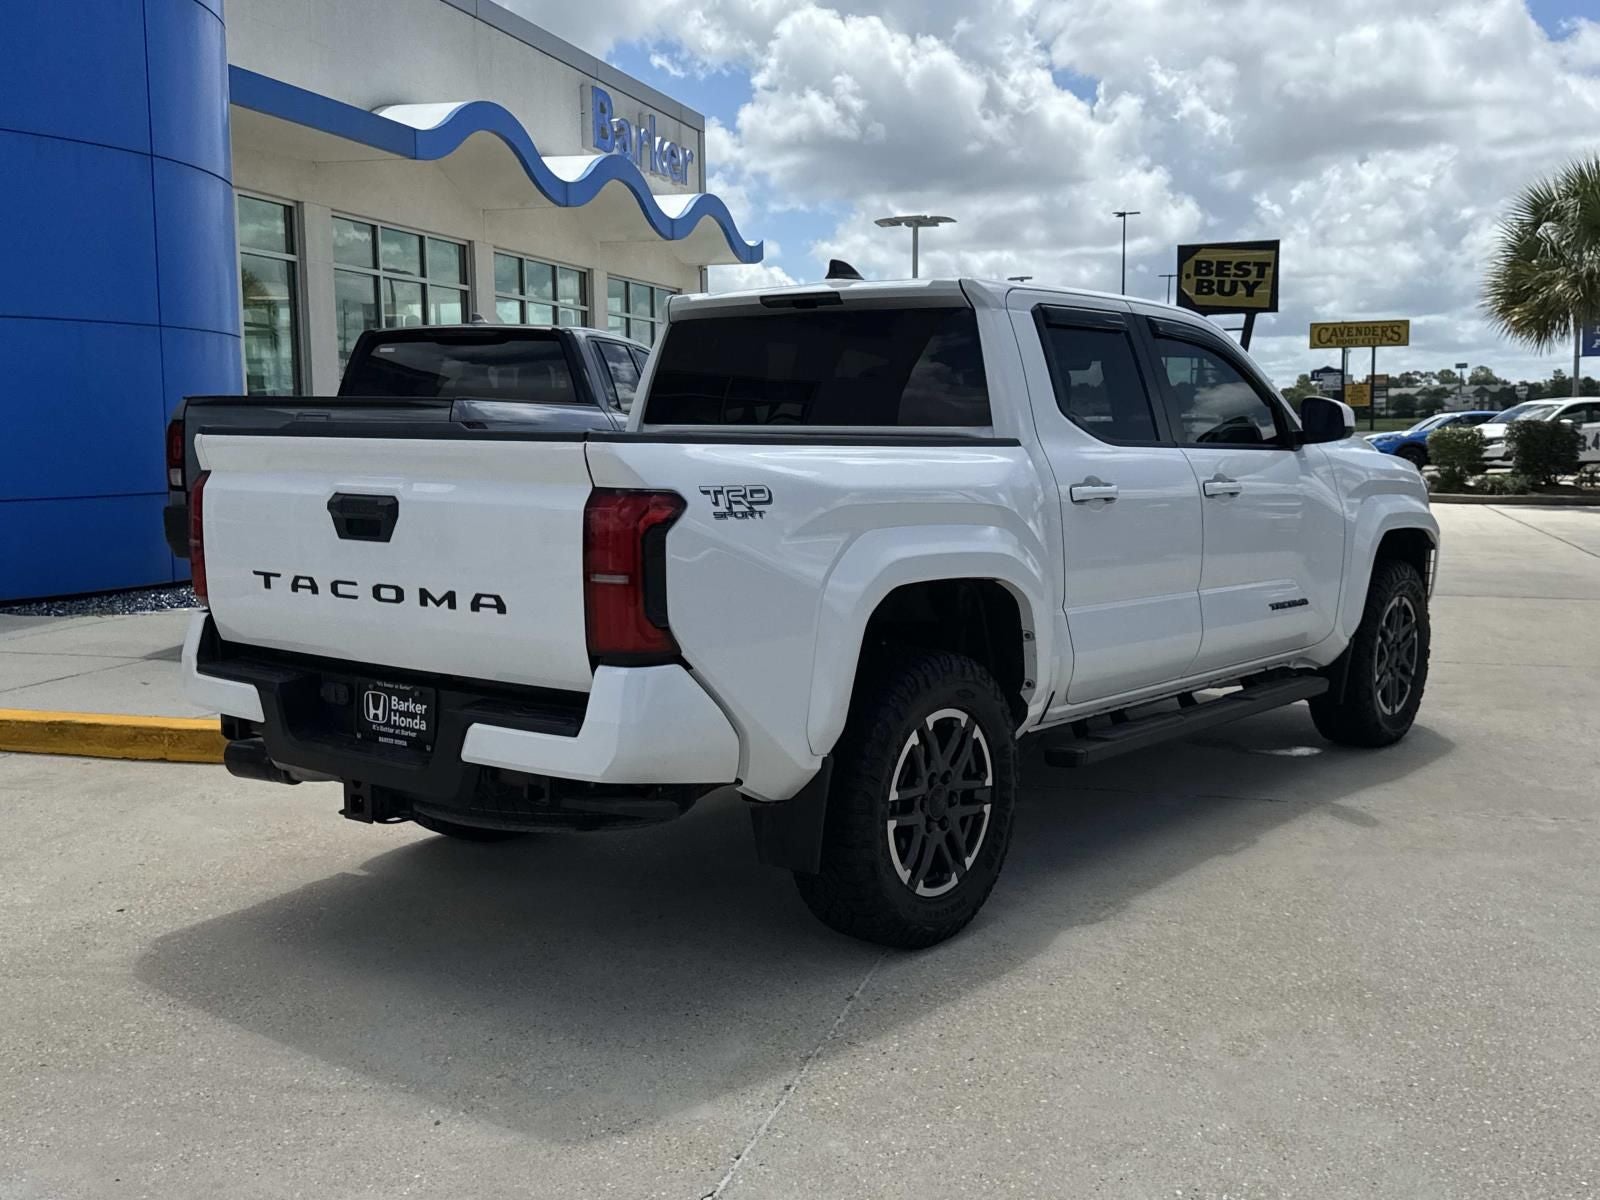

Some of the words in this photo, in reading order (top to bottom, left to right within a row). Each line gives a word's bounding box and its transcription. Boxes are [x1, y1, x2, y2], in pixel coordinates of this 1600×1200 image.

[591, 85, 694, 185] Barker
[1193, 260, 1271, 279] BEST
[1195, 279, 1263, 297] BUY
[698, 484, 773, 511] TRD
[712, 510, 766, 520] SPORT
[252, 570, 507, 615] TACOMA
[391, 695, 427, 714] Barker
[390, 711, 426, 731] Honda
